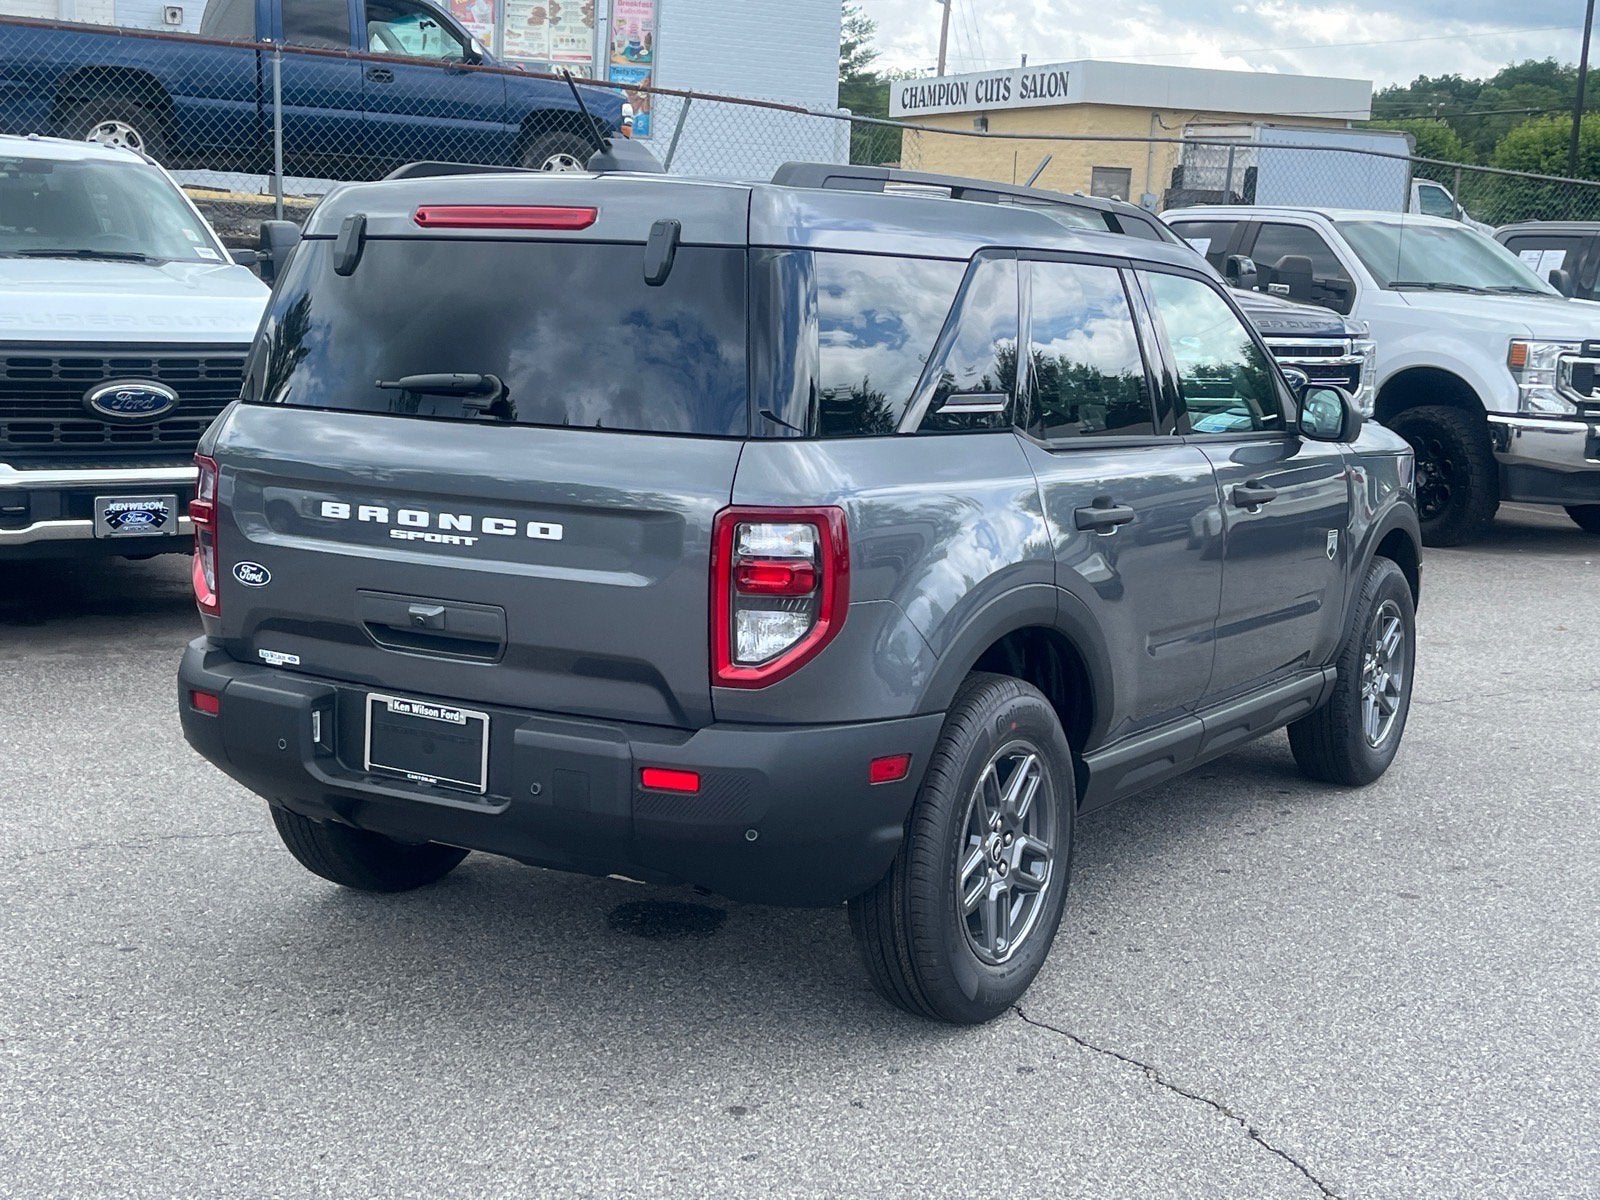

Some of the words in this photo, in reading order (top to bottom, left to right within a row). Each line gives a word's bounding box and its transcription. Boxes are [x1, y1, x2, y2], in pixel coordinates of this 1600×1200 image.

[902, 82, 969, 109] CHAMPION
[975, 76, 1011, 103] CUTS
[1019, 71, 1070, 100] SALON
[112, 391, 155, 410] Ford
[109, 503, 127, 511] KEN
[128, 501, 164, 510] WILSON
[125, 513, 148, 523] Ford
[321, 501, 563, 541] BRONCO
[390, 529, 478, 546] SPORT
[239, 565, 263, 583] Ford
[393, 700, 410, 712] Ken
[411, 703, 439, 717] Wilson
[440, 709, 460, 721] Ford
